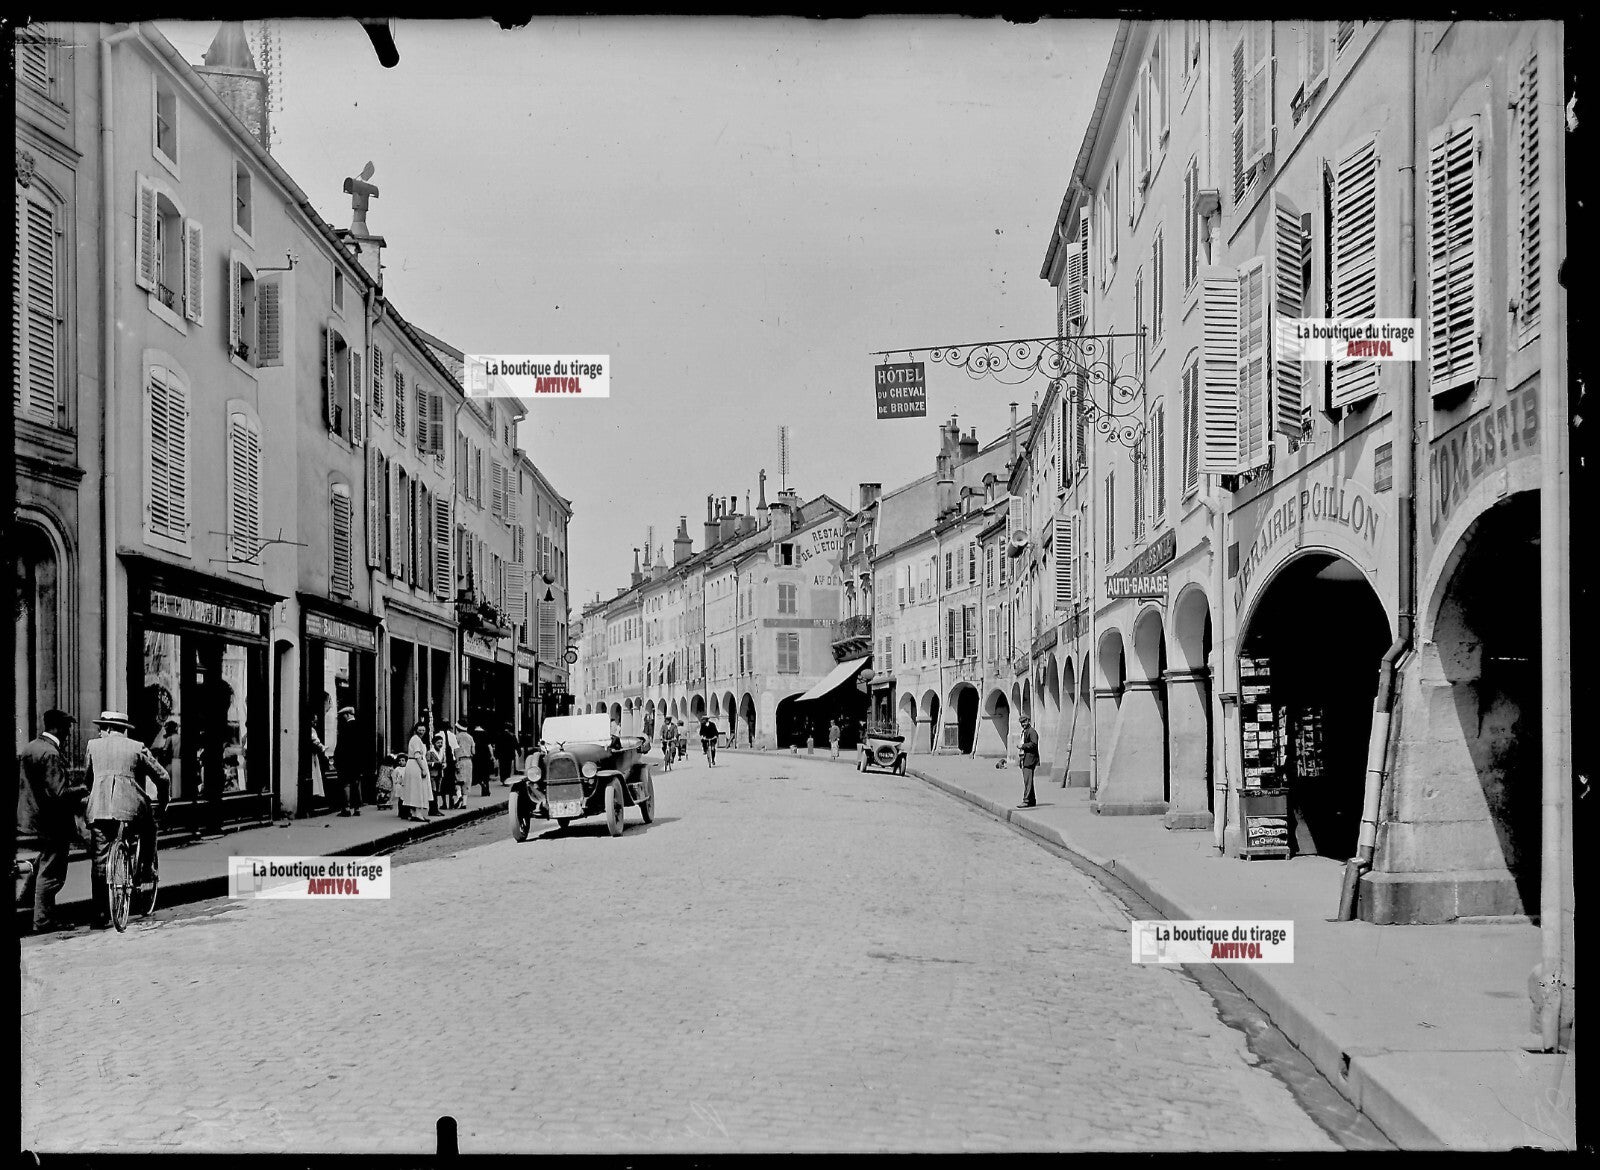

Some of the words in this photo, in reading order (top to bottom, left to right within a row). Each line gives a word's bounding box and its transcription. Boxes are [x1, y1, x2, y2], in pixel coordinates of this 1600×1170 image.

[877, 366, 923, 384] HÔTEL
[878, 391, 887, 399] DU
[890, 387, 925, 398] CHEVAL
[891, 401, 925, 413] BRONZE
[801, 548, 813, 561] DE
[1234, 495, 1297, 615] LIBRAIRIE
[1312, 481, 1379, 547] GILLON
[1107, 576, 1168, 595] AUTO-GARAGE
